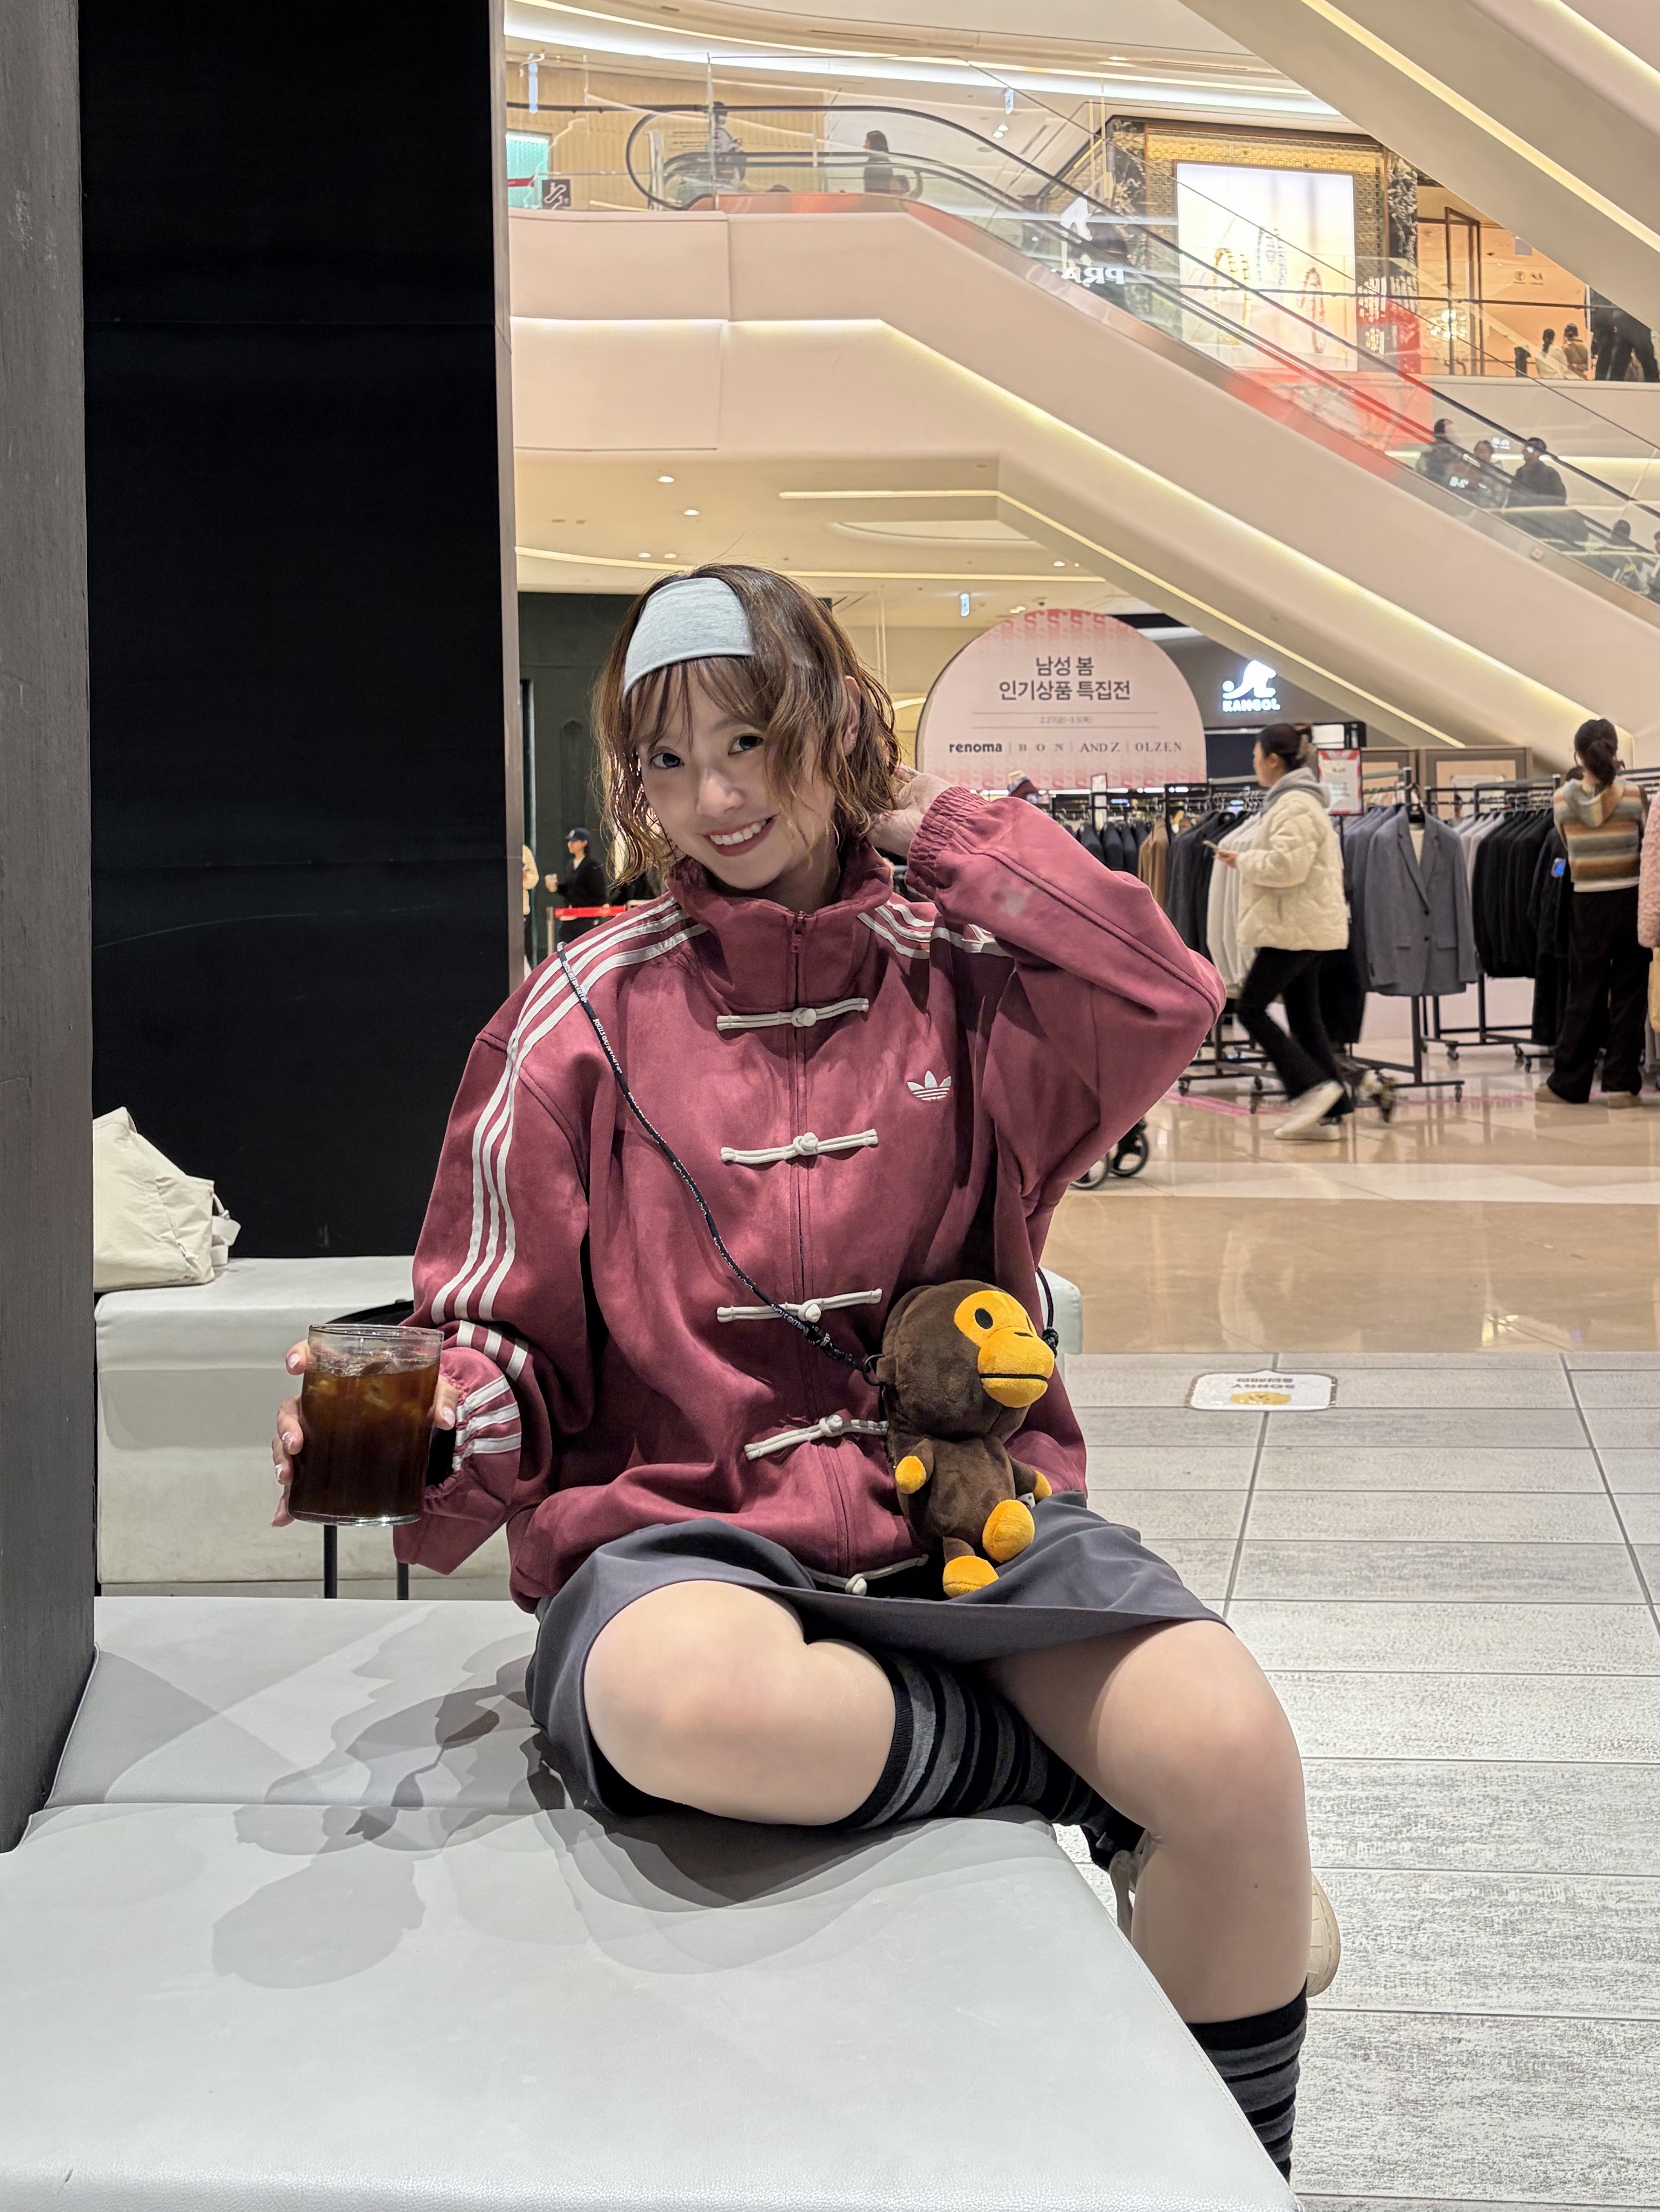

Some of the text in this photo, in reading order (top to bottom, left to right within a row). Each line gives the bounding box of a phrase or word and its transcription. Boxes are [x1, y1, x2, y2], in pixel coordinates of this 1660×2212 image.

[1036, 656, 1094, 676] 남성 봄
[999, 680, 1131, 701] 인기상품 특집전
[1222, 698, 1281, 712] KANGOL
[949, 743, 1003, 753] renoma
[1135, 741, 1183, 752] OLZEN
